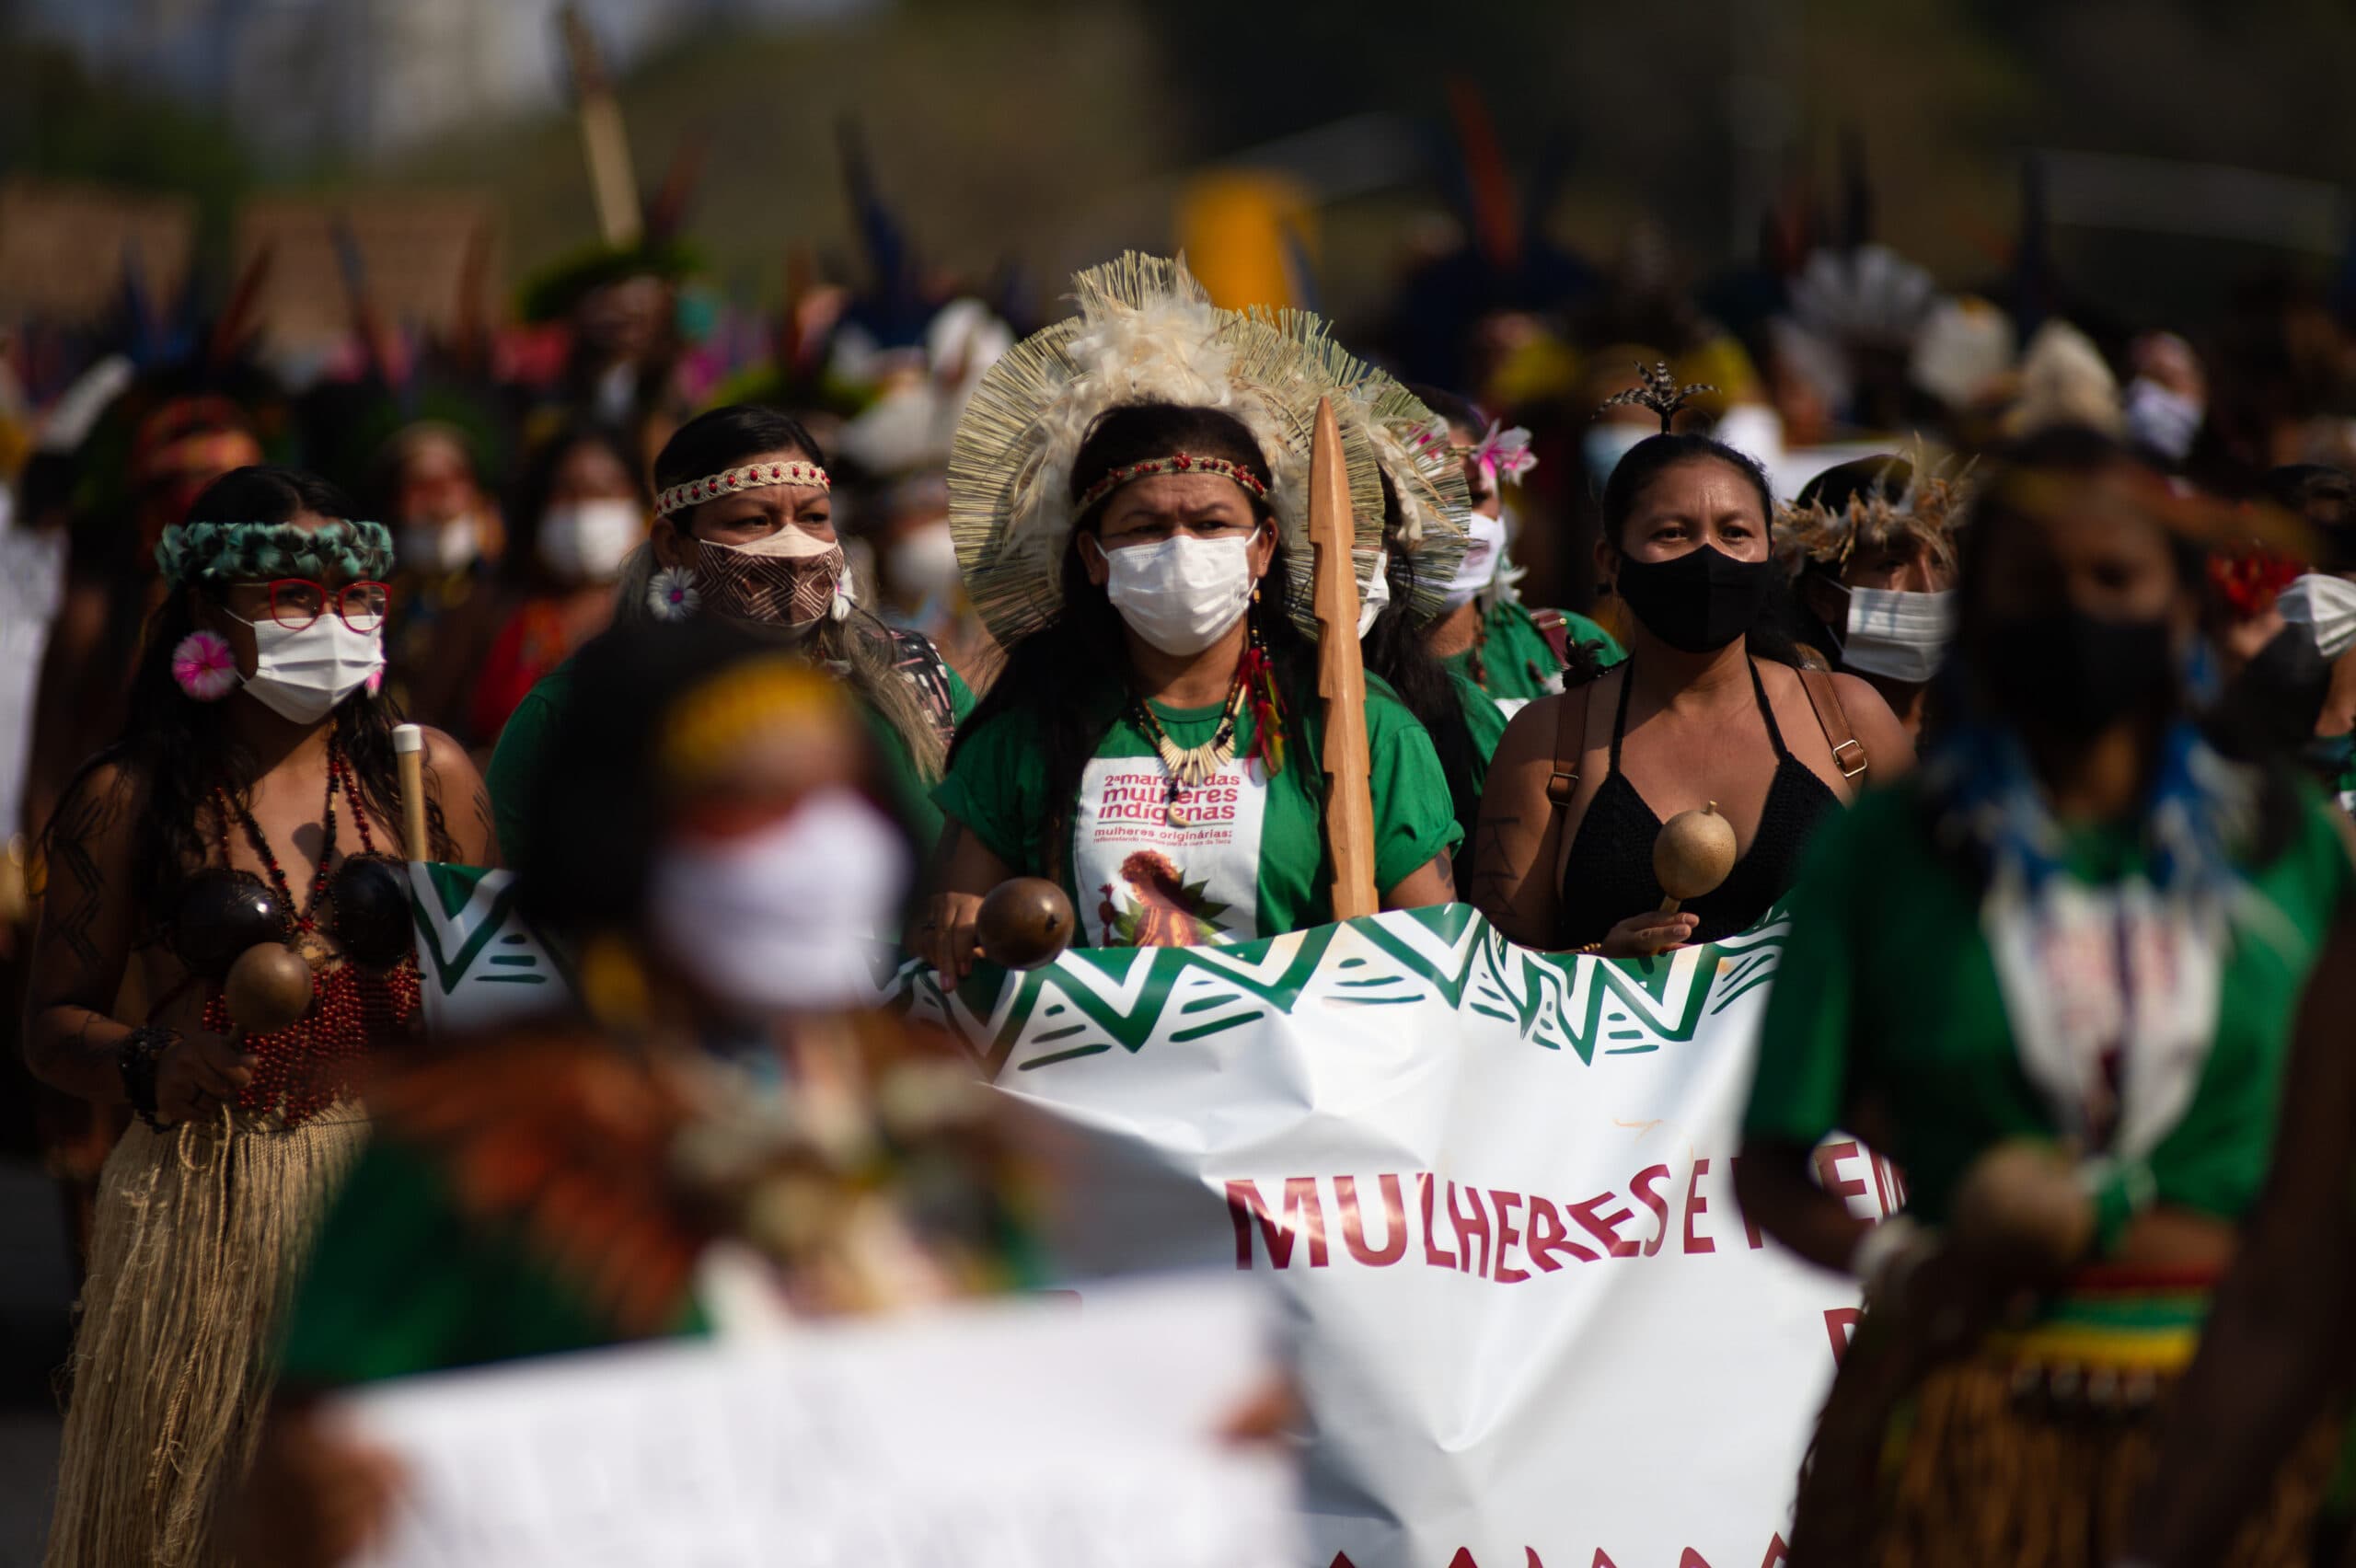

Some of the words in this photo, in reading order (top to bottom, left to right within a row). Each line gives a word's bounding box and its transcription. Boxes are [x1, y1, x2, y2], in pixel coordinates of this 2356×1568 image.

[1204, 773, 1240, 786] das
[1094, 826, 1154, 837] mulheres
[1223, 1163, 1671, 1285] MULHERES
[1683, 1159, 1716, 1255] E
